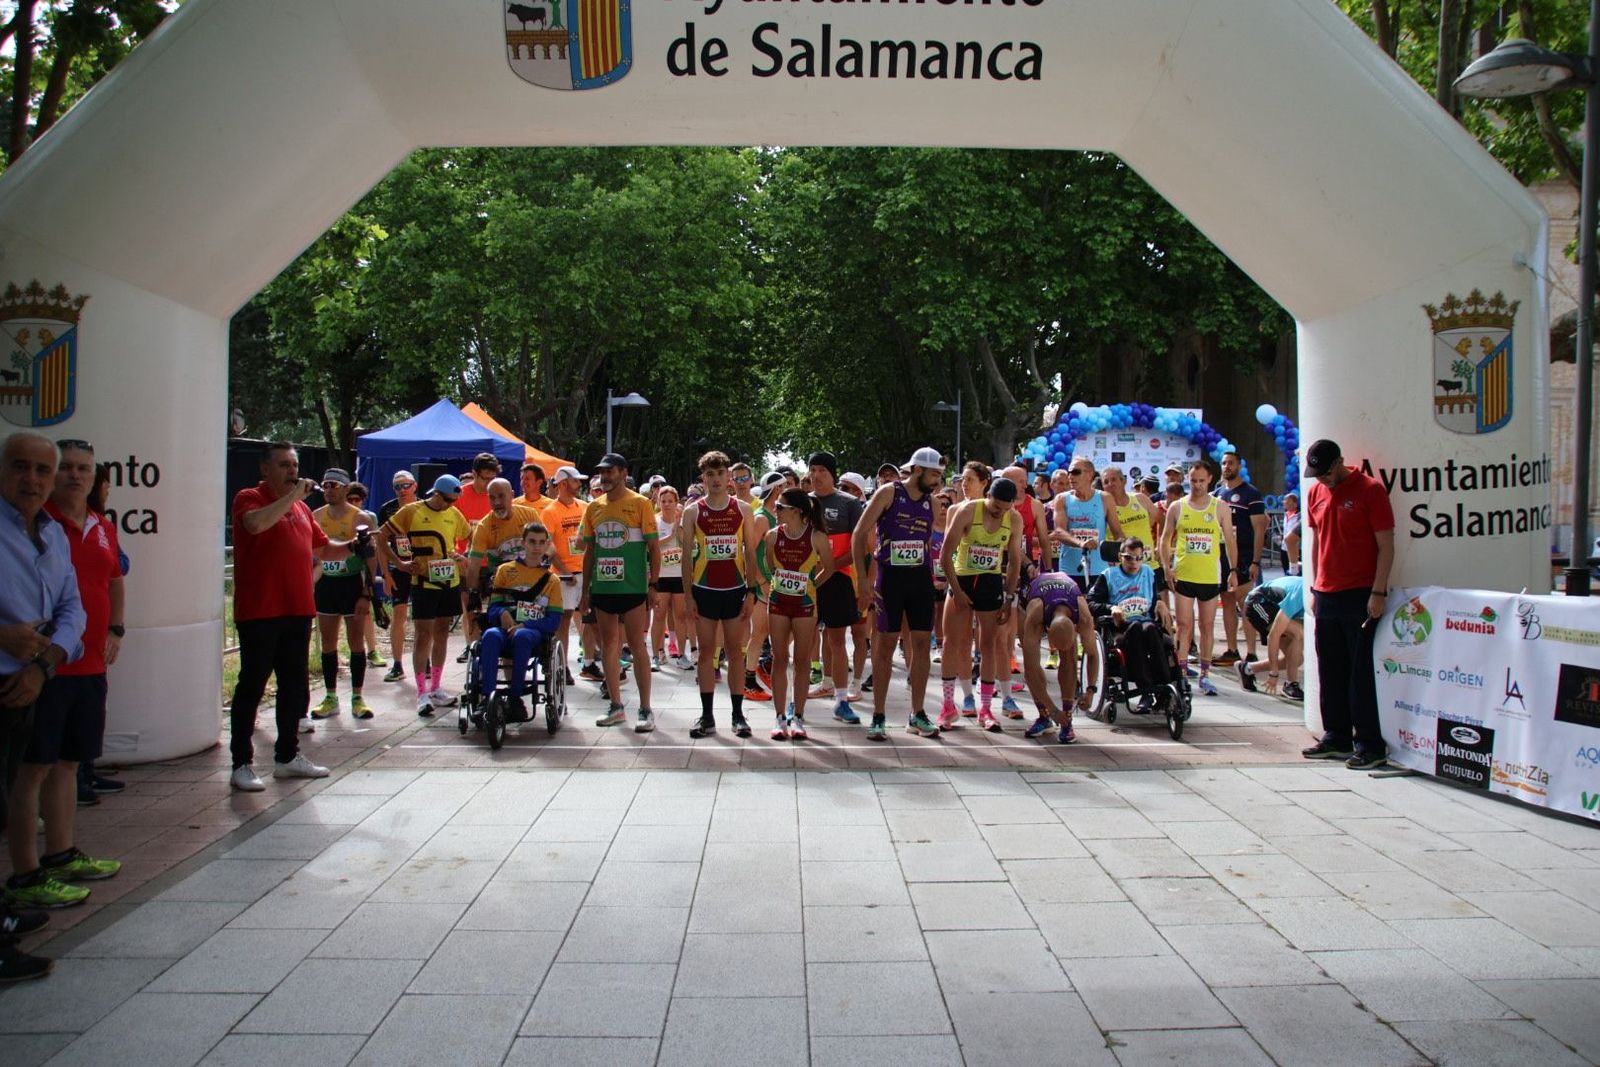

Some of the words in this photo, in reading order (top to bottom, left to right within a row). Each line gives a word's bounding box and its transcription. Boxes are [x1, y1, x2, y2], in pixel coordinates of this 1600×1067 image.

[667, 22, 729, 77] de
[752, 22, 1043, 80] Salamanca
[1410, 503, 1551, 539] Salamanc
[711, 545, 731, 554] 356
[1189, 542, 1208, 550] 378
[898, 550, 918, 559] 420
[973, 555, 993, 566] 309
[323, 561, 340, 571] 367
[601, 566, 618, 575] 408
[435, 567, 451, 576] 317
[780, 580, 801, 590] 409
[1125, 603, 1144, 612] 374
[1446, 618, 1495, 635] bedunia
[1438, 742, 1492, 767] MIRATONDA
[1442, 763, 1484, 782] GUIJUELO
